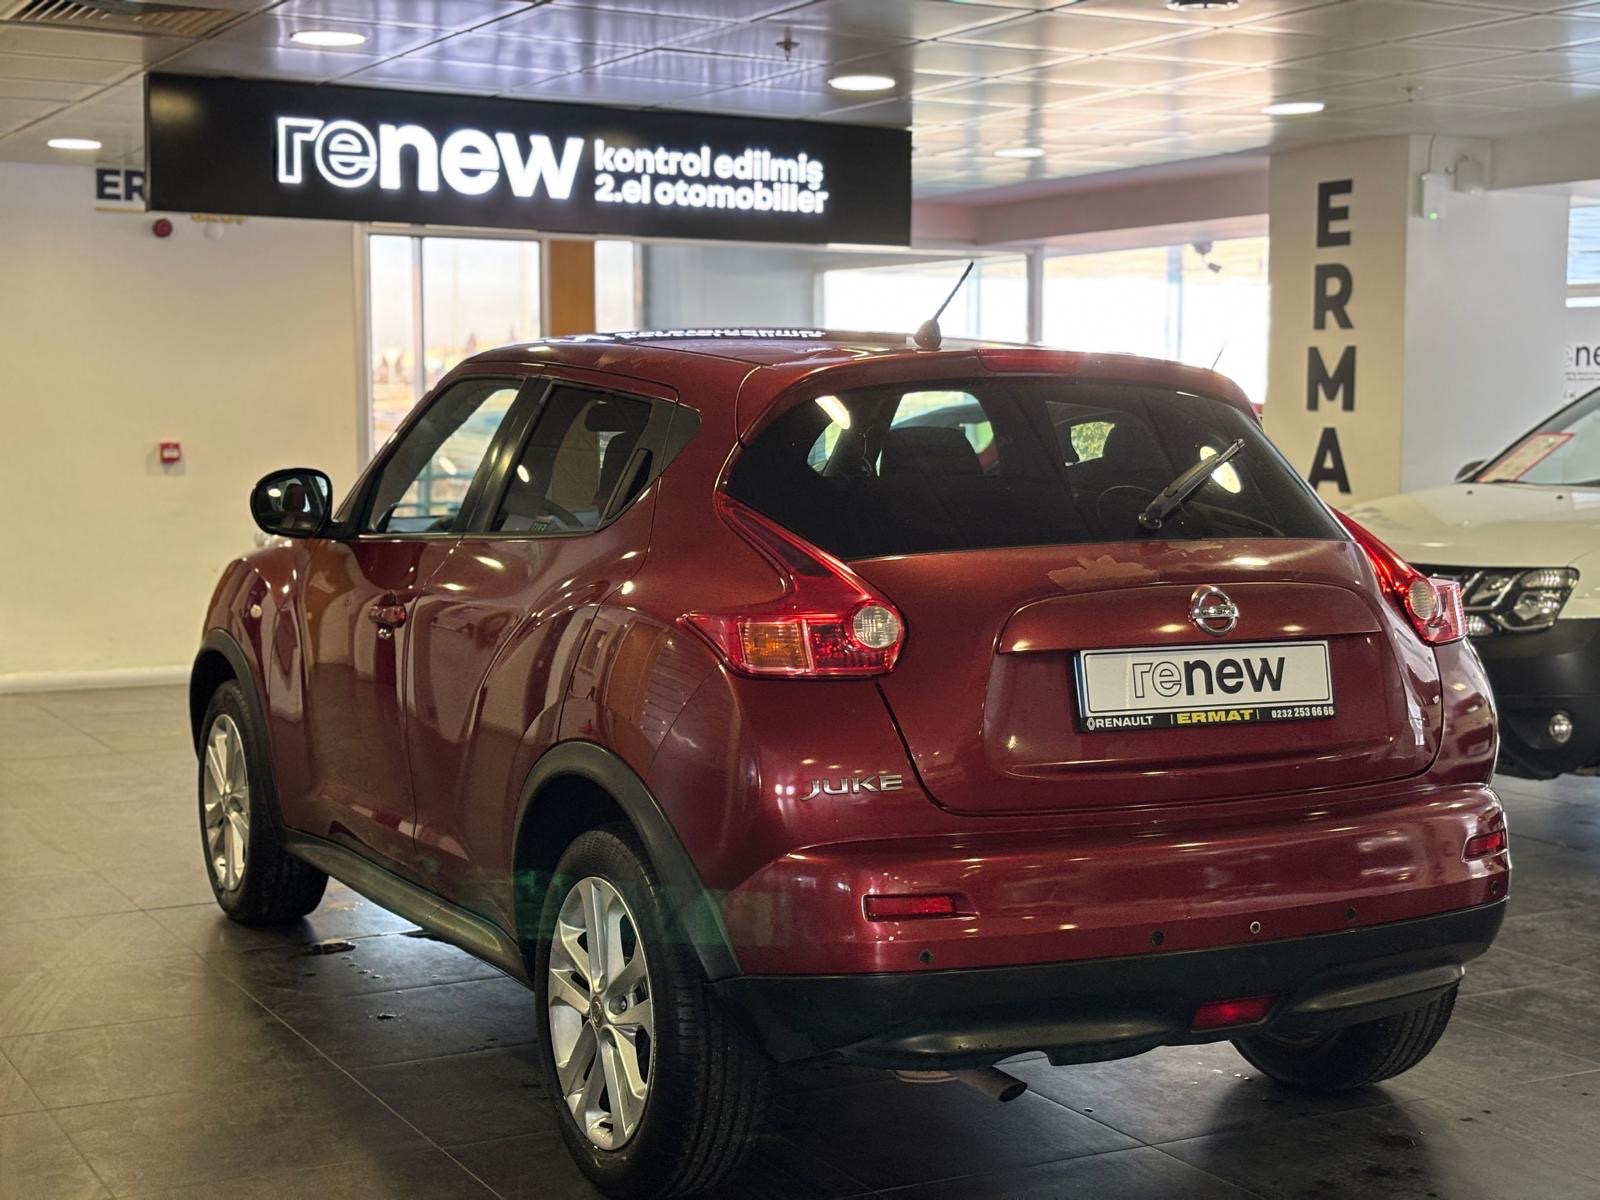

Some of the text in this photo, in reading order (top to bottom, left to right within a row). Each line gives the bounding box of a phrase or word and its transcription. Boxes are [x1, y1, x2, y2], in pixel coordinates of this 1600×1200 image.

[276, 116, 585, 200] renew
[594, 138, 711, 177] kontrol
[594, 173, 830, 214] 2.el otomobiller
[1132, 656, 1286, 699] renew
[1096, 715, 1154, 728] RENAULT
[1177, 709, 1254, 724] ERMAT
[799, 774, 904, 801] JUKE
